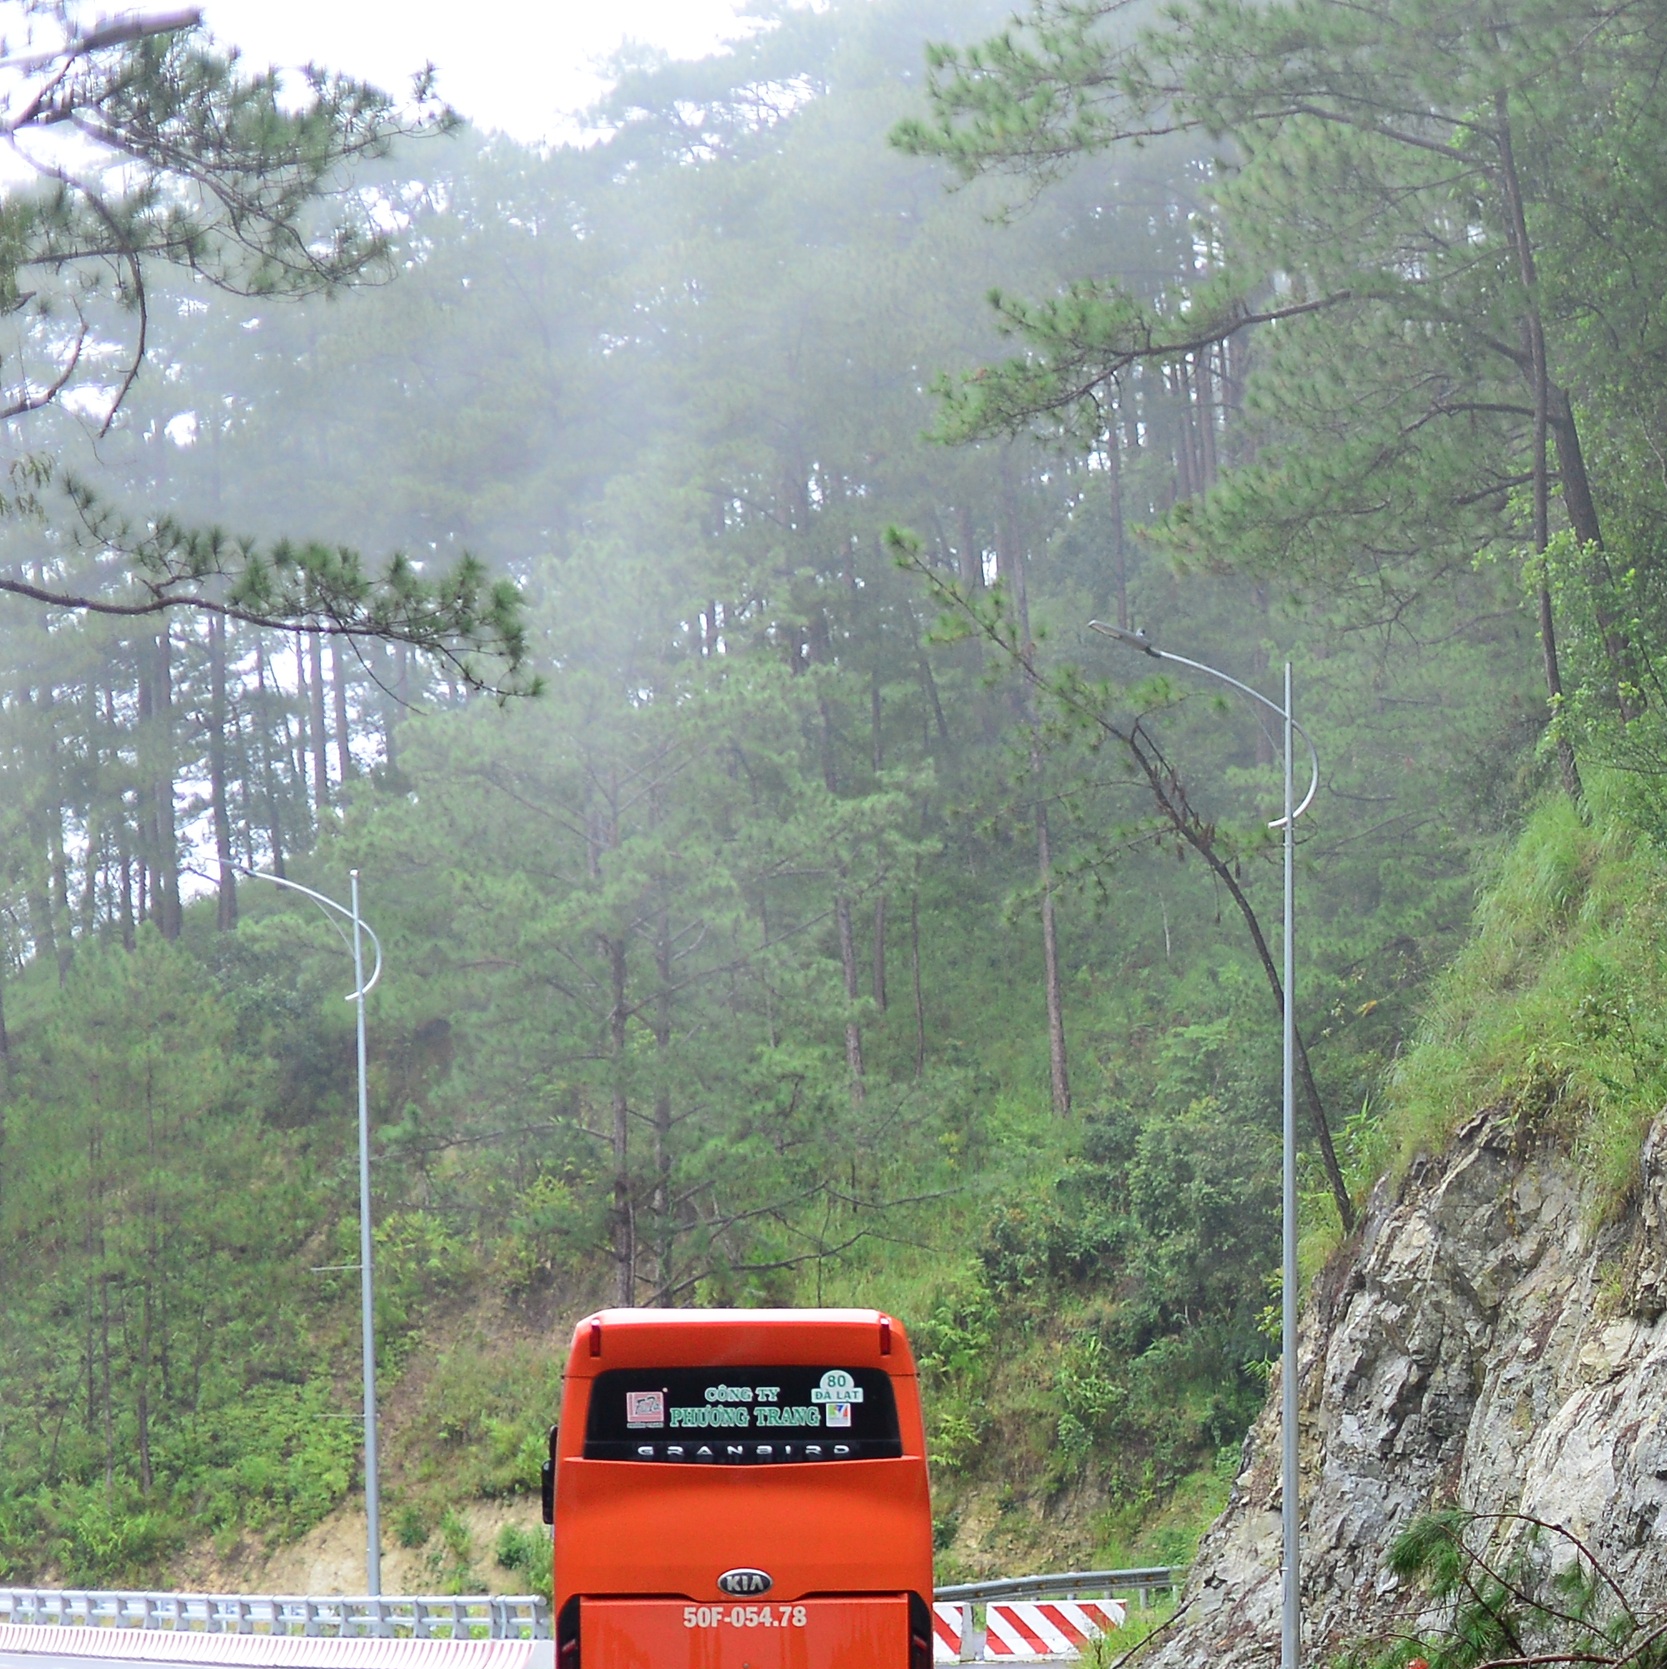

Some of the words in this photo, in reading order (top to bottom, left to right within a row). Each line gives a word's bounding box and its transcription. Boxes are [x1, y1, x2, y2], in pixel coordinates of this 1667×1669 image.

[828, 1375, 846, 1387] 80
[705, 1384, 752, 1403] CÔNG
[756, 1386, 781, 1402] TY
[836, 1390, 860, 1402] LẠT
[753, 1406, 821, 1428] TRANG
[637, 1444, 851, 1456] GRANBIRD
[725, 1575, 765, 1592] KIA
[683, 1605, 807, 1628] 50F-054.78
